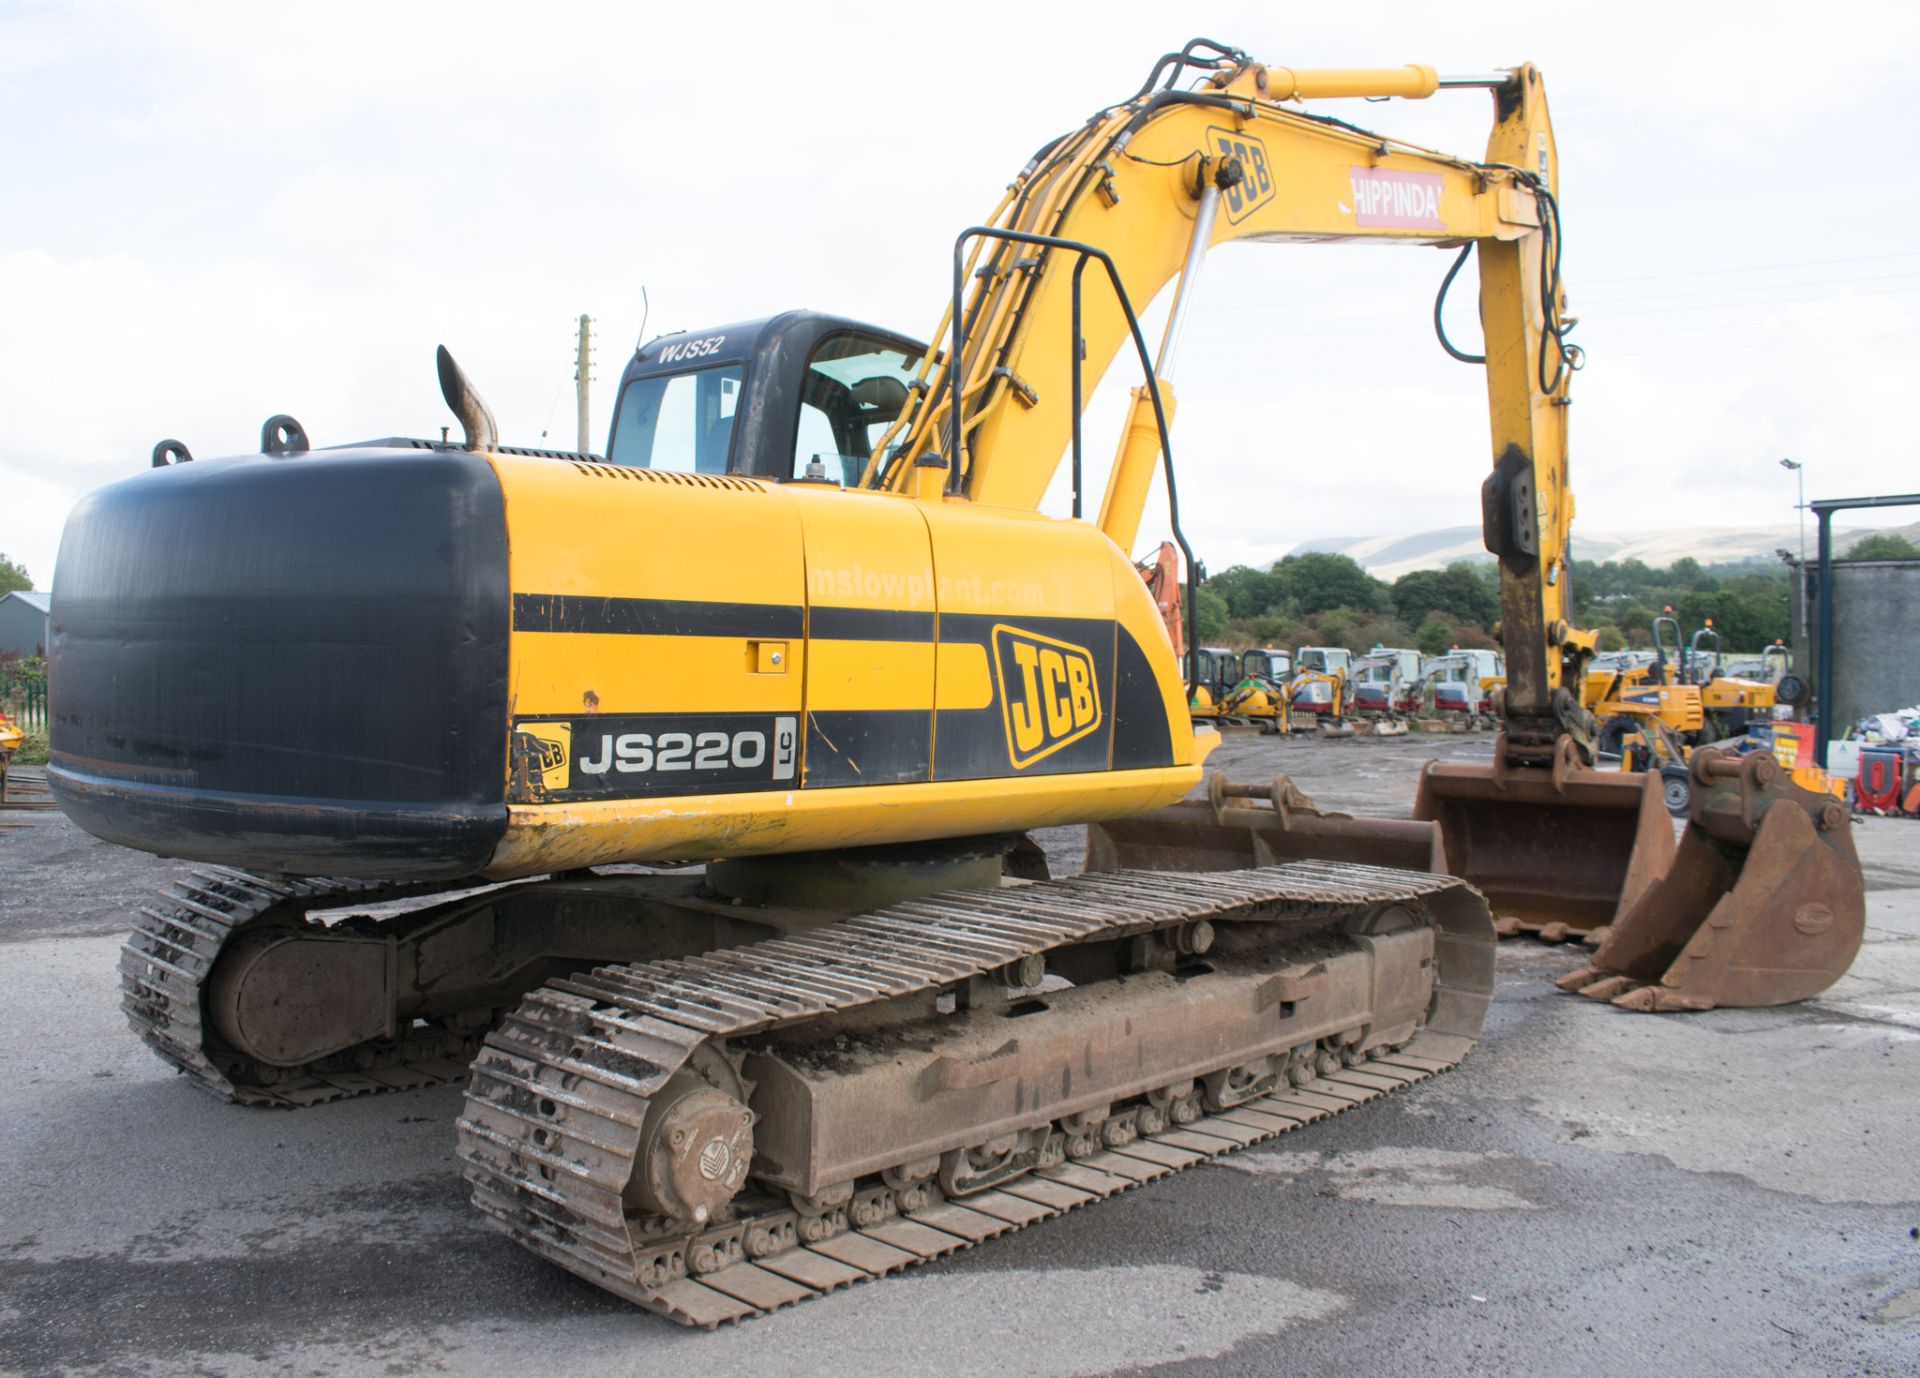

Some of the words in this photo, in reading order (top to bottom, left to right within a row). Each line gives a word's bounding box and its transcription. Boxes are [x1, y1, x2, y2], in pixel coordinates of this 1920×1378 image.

[1338, 178, 1443, 219] HIPPINDA
[659, 336, 726, 364] WJS52
[808, 563, 1045, 608] mslowplant.com
[1012, 641, 1094, 752] JCB
[579, 731, 766, 774] JS220
[779, 731, 792, 764] LC
